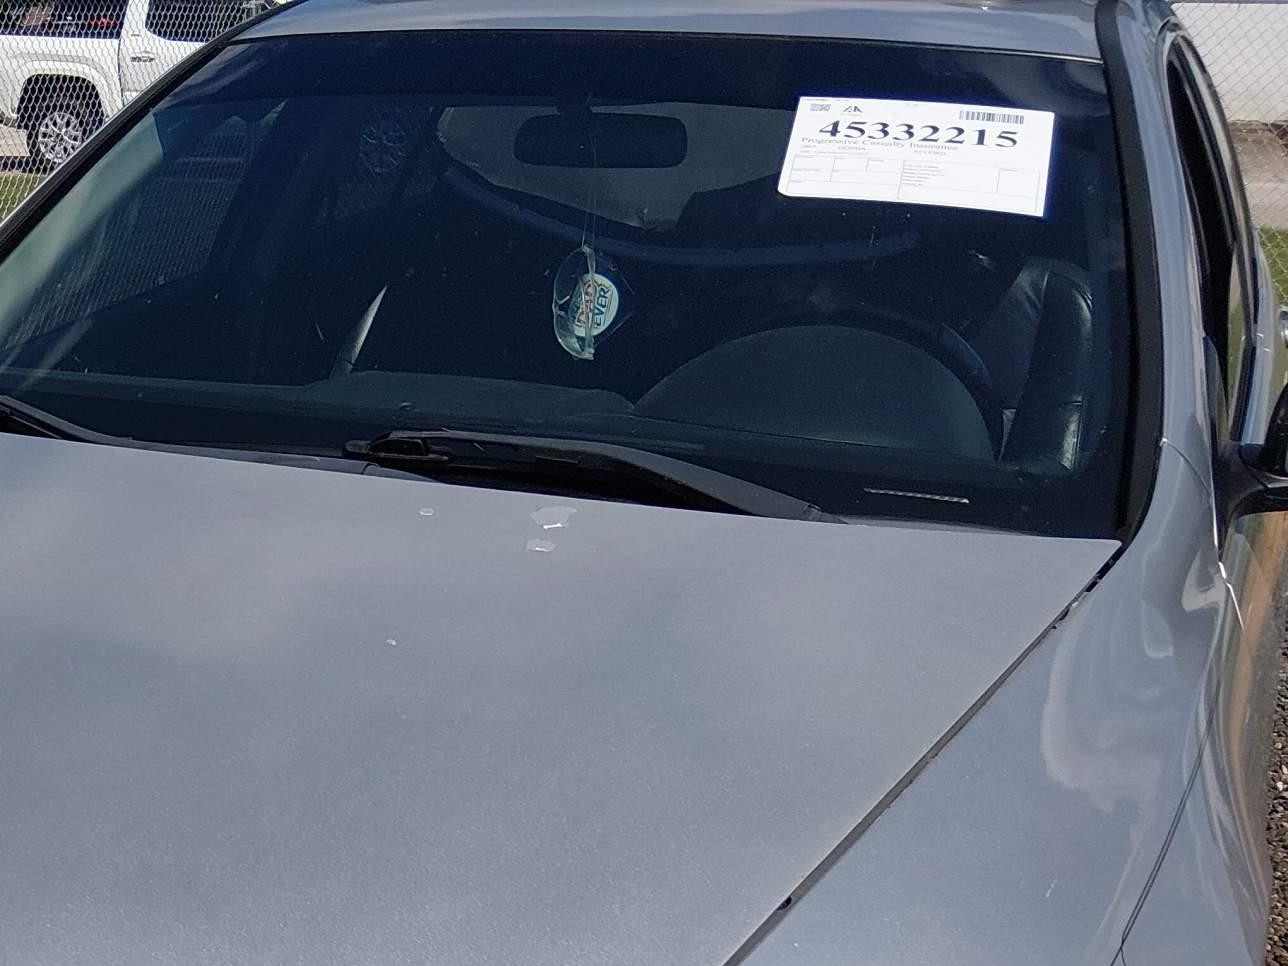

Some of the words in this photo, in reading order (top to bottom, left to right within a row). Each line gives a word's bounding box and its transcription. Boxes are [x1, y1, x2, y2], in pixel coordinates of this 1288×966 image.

[801, 137, 859, 146] Progressive
[862, 139, 906, 149] Casualty
[909, 142, 959, 151] Insurance
[819, 120, 1019, 148] 45332215
